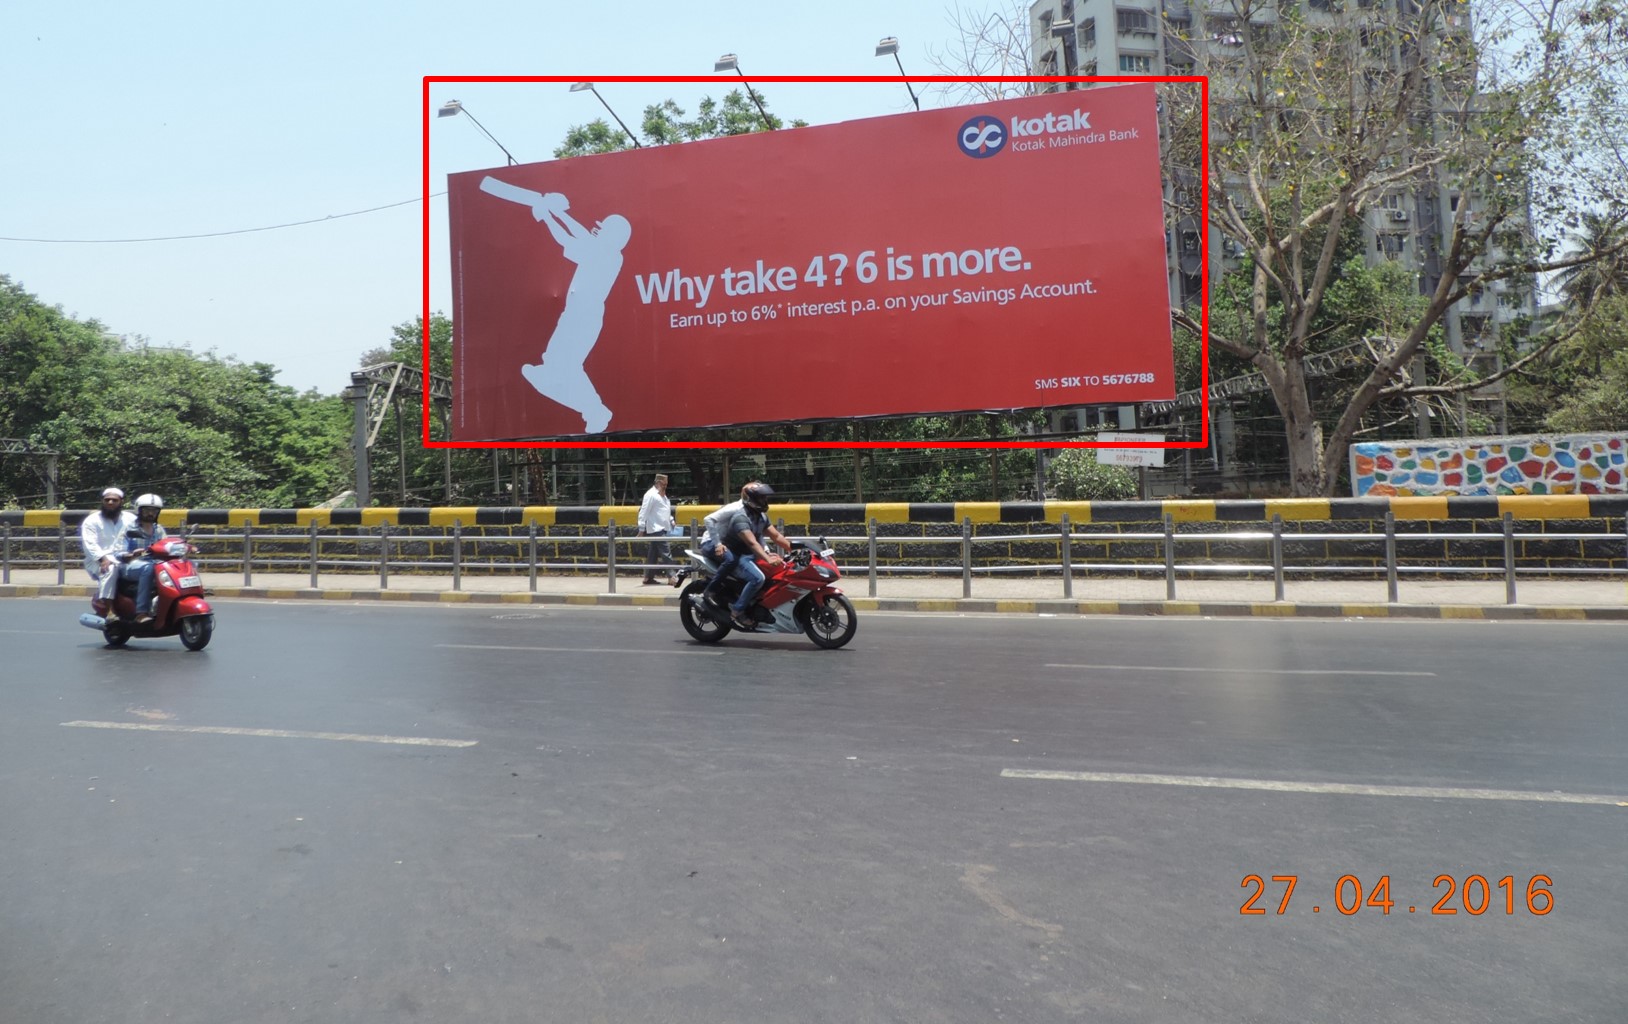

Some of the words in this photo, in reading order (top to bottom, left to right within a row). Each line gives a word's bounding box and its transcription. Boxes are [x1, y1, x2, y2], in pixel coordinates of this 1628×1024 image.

[1011, 109, 1092, 138] kotak
[1012, 138, 1046, 152] Kotak
[1049, 132, 1106, 148] Mahindra
[1109, 128, 1139, 141] Bank
[635, 268, 716, 308] Why
[720, 259, 798, 297] take
[803, 253, 849, 288] 4?
[855, 251, 879, 284] 6
[886, 247, 914, 281] is
[921, 246, 1032, 279] more.
[669, 313, 703, 328] Earn
[707, 312, 727, 328] up
[729, 308, 748, 323] to
[787, 299, 847, 318] interest
[851, 299, 880, 317] p.a.
[884, 297, 907, 310] on
[910, 293, 949, 312] your
[952, 286, 1016, 306] Savings
[1019, 279, 1098, 299] Account.
[1034, 378, 1058, 390] SMS
[1060, 376, 1081, 388] SIX
[1083, 375, 1100, 387] TO
[1102, 372, 1155, 386] 5676788
